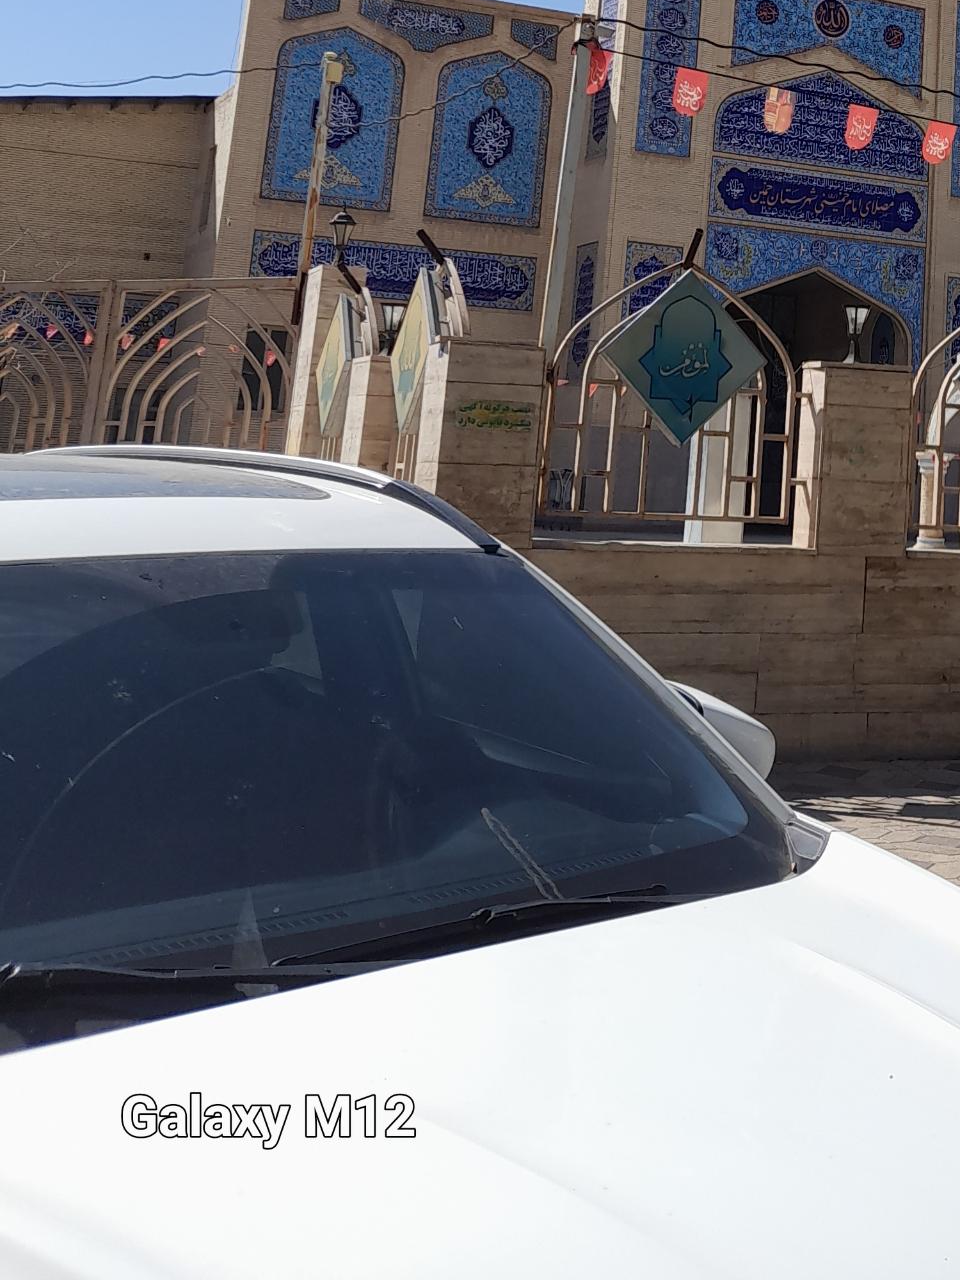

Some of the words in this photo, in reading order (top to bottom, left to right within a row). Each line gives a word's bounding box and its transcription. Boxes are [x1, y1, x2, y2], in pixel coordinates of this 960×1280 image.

[749, 182, 773, 204] خمین
[767, 187, 817, 208] شهرستان
[814, 191, 850, 213] خمینی
[844, 199, 861, 217] امام
[861, 199, 894, 218] مصلای
